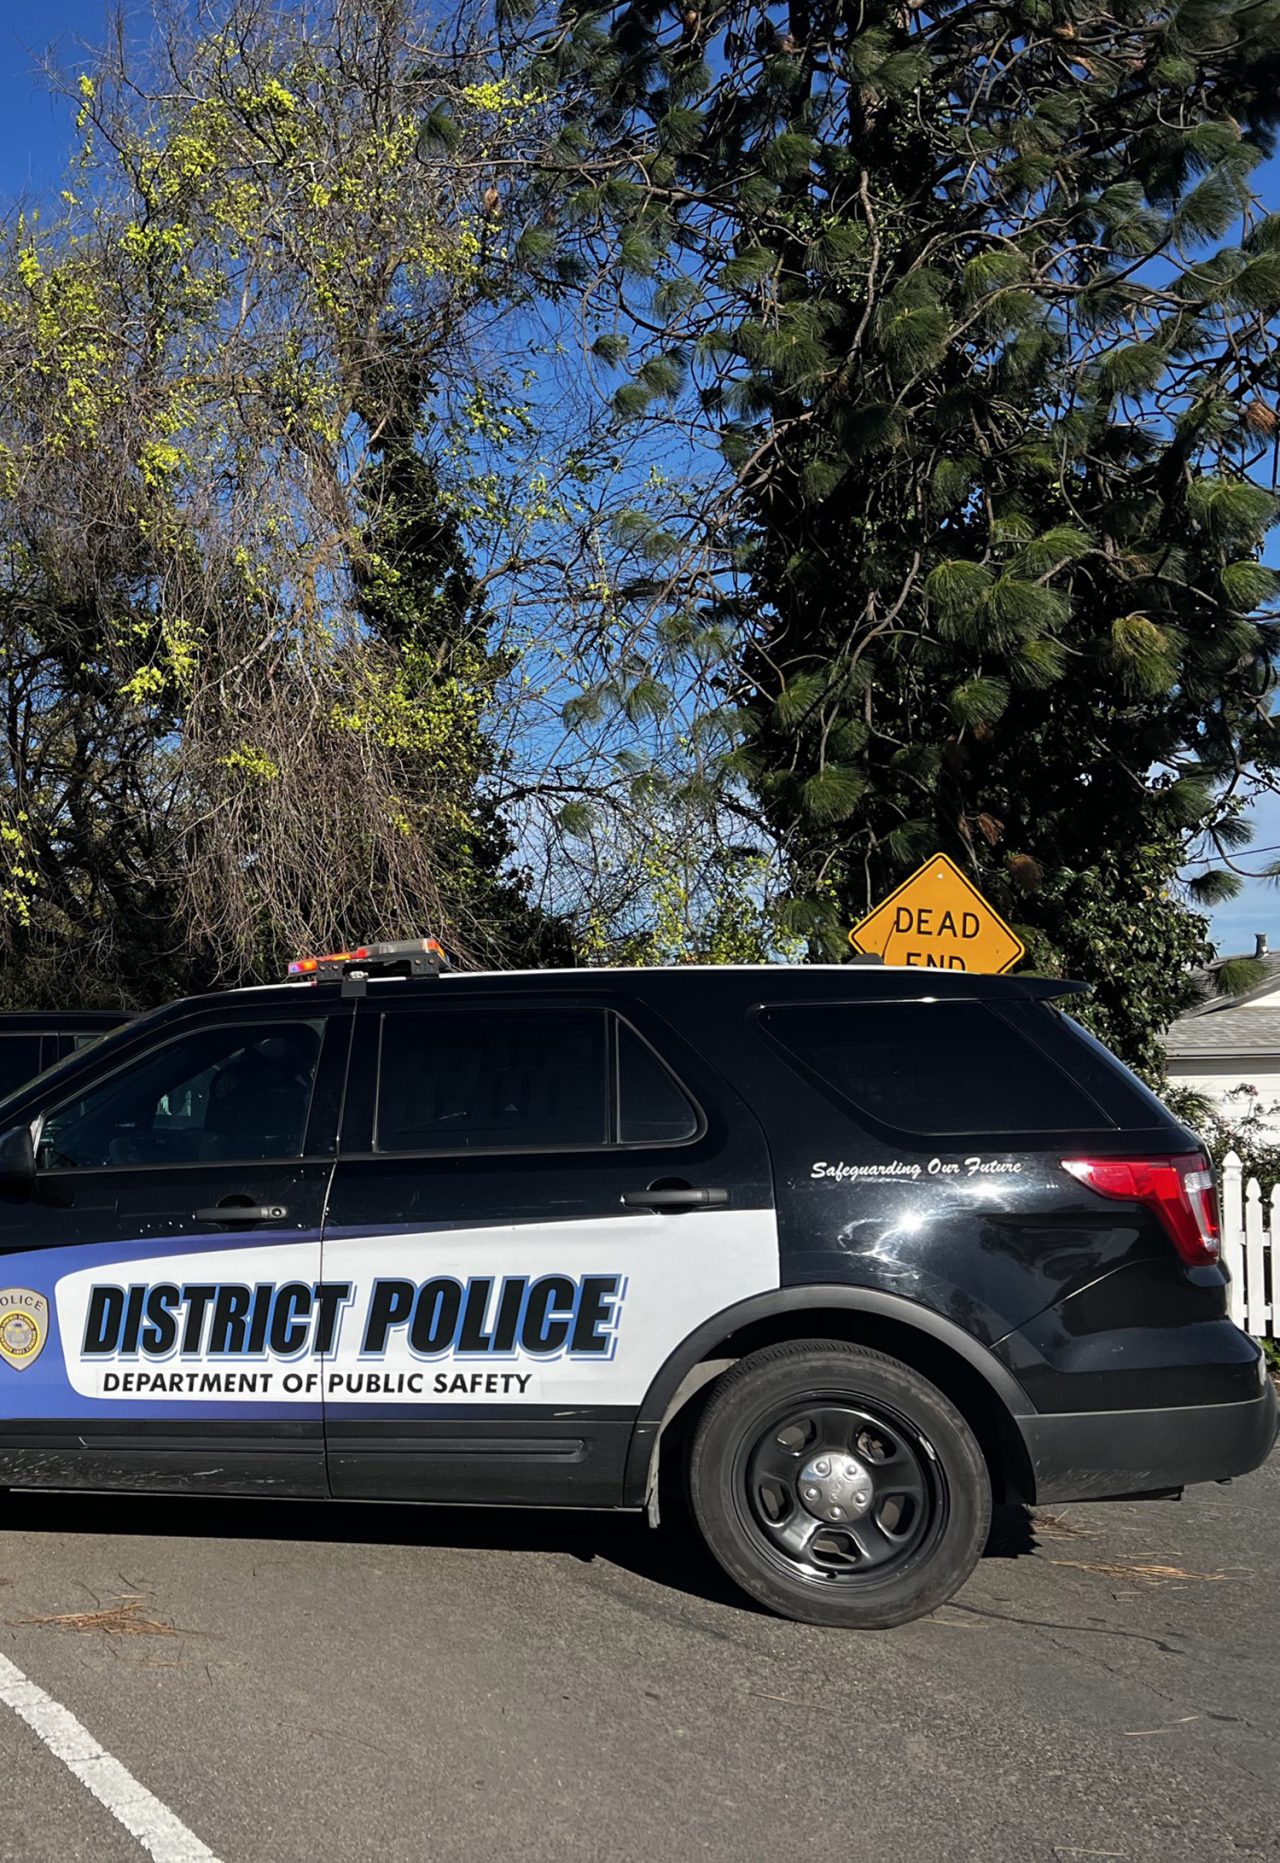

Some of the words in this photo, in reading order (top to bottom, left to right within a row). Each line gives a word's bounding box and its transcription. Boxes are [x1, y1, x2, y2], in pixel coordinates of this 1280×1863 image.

[894, 906, 981, 939] DEAD
[906, 952, 967, 971] END
[810, 1160, 922, 1181] Safeguarding
[927, 1158, 960, 1175] Our
[964, 1157, 1022, 1176] Future
[80, 1281, 357, 1363] DISTRICT
[357, 1273, 629, 1363] POLICE
[103, 1372, 273, 1393] DEPARTMENT
[282, 1373, 319, 1394] OF
[328, 1373, 424, 1394] PUBLIC
[432, 1373, 533, 1394] SAFETY
